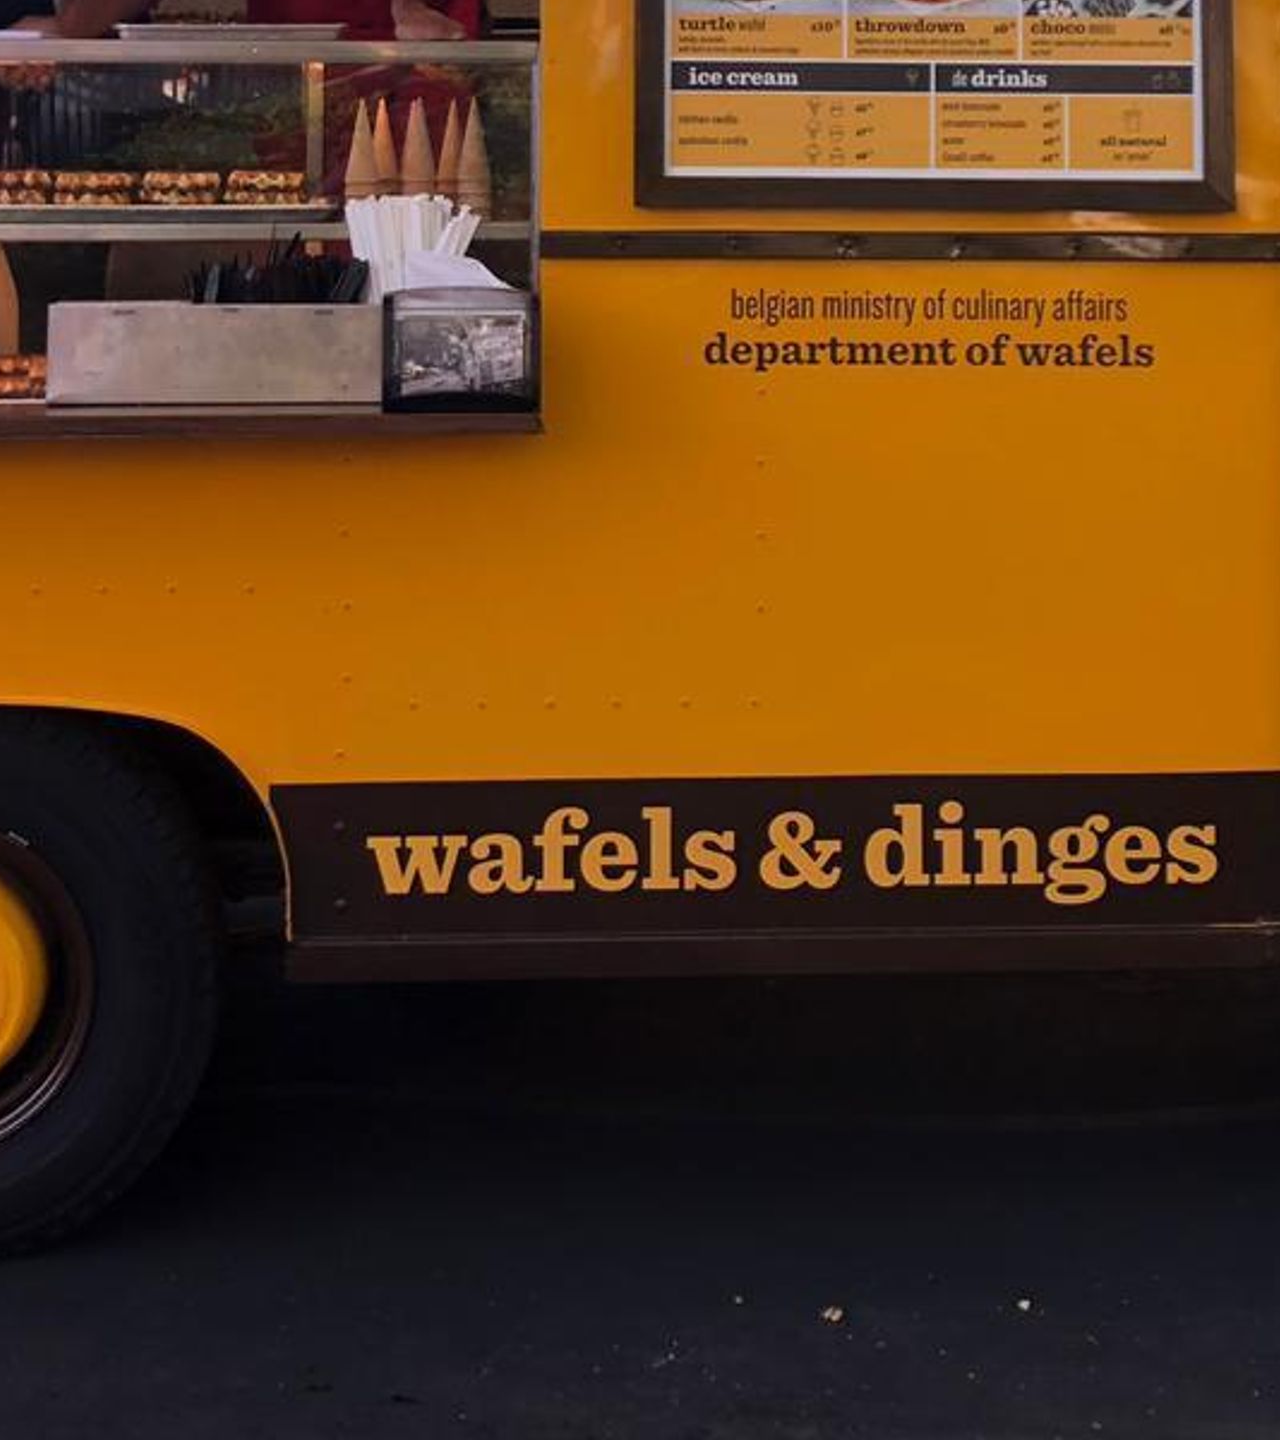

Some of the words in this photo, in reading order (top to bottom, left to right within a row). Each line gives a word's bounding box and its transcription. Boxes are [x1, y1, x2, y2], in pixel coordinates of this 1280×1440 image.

[678, 16, 736, 33] turtle
[854, 18, 966, 34] throwdown
[1029, 19, 1086, 35] choco
[688, 67, 723, 86] ice
[726, 68, 799, 86] cream
[970, 68, 1048, 88] drinks
[730, 289, 814, 327] belgian
[821, 290, 916, 327] ministry
[923, 289, 947, 320] of
[952, 290, 1045, 327] culinary
[1052, 291, 1128, 322] affairs
[704, 332, 956, 371] department
[965, 333, 1011, 367] of
[1016, 333, 1155, 367] wafels
[366, 806, 738, 896] wafels
[760, 811, 843, 891] &
[864, 800, 1218, 905] dinges
